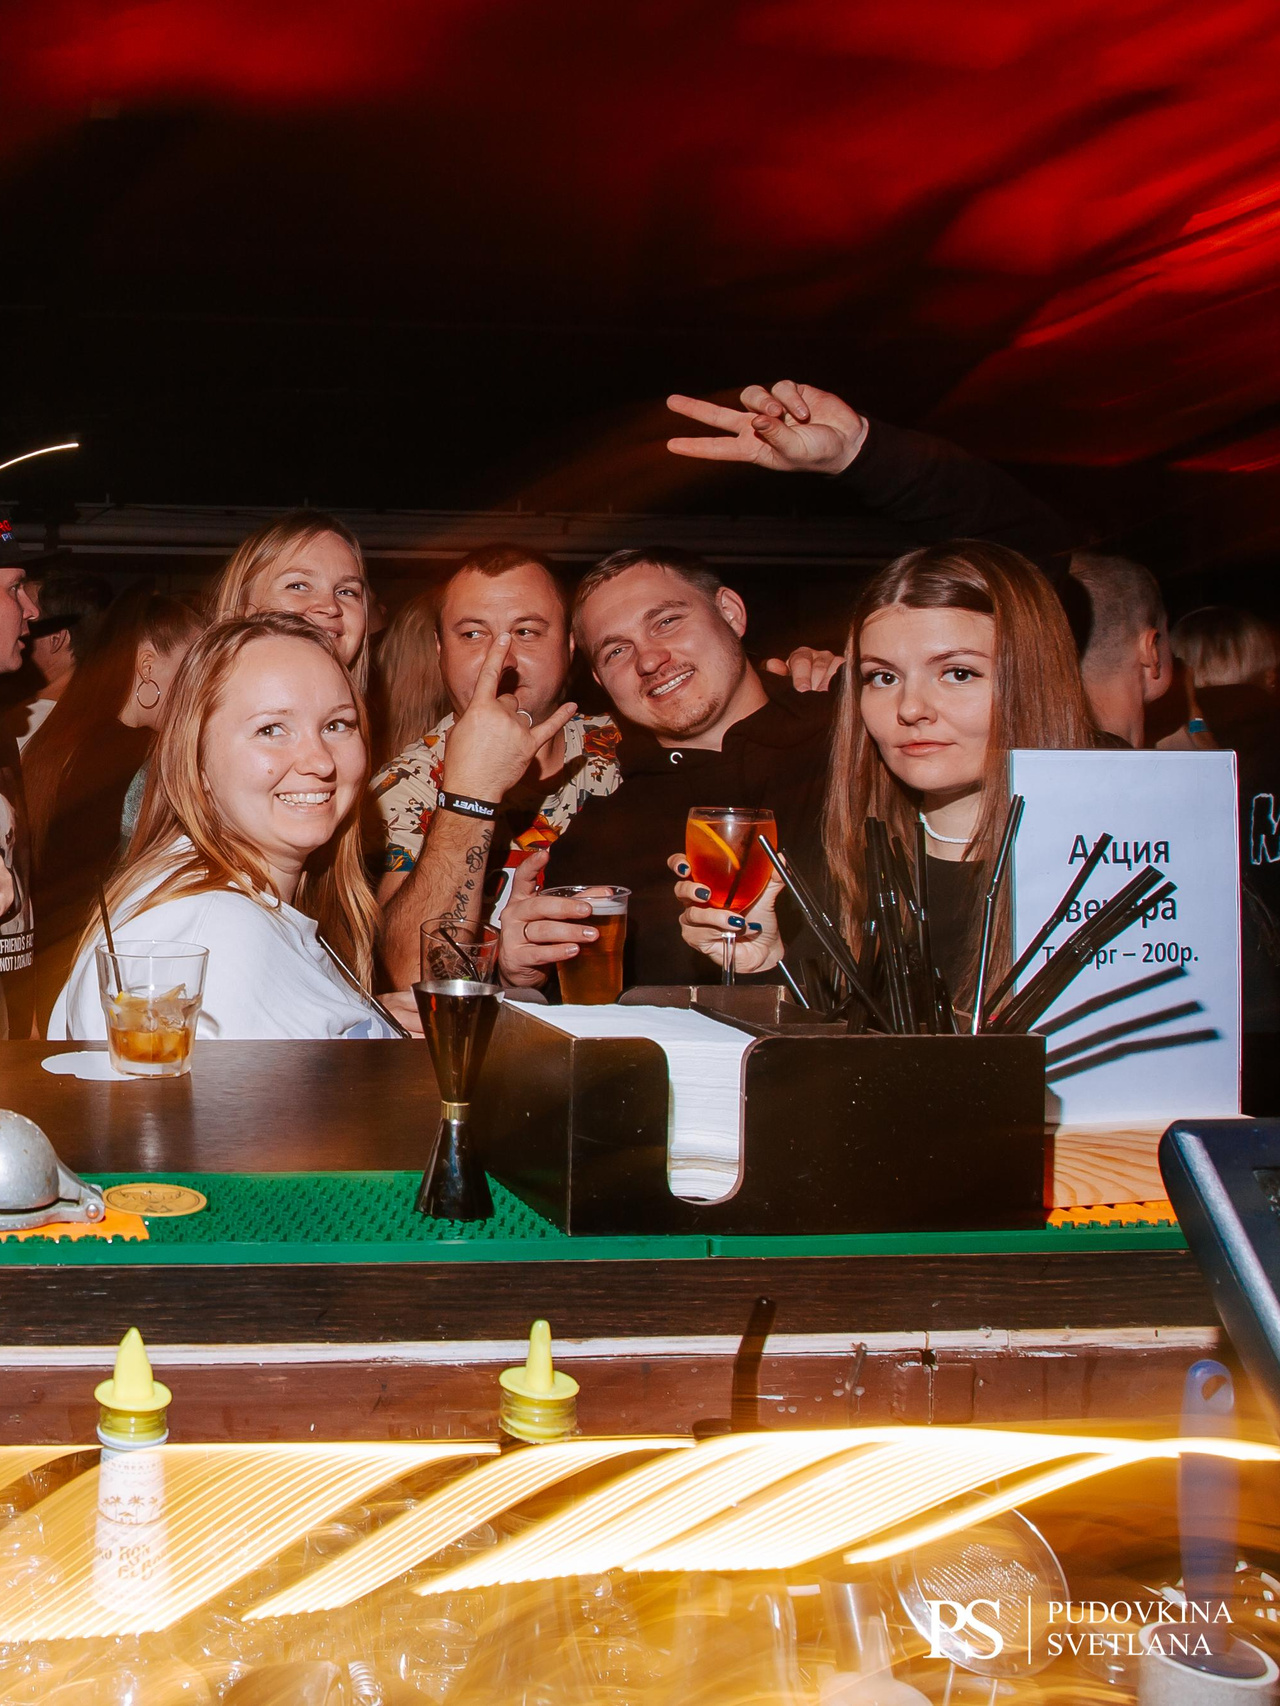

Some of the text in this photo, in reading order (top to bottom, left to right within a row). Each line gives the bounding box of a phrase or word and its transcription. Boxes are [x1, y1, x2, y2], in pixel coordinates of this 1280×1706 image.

[1064, 895, 1177, 929] вера
[0, 956, 13, 972] NOT
[1141, 942, 1198, 966] 200р.
